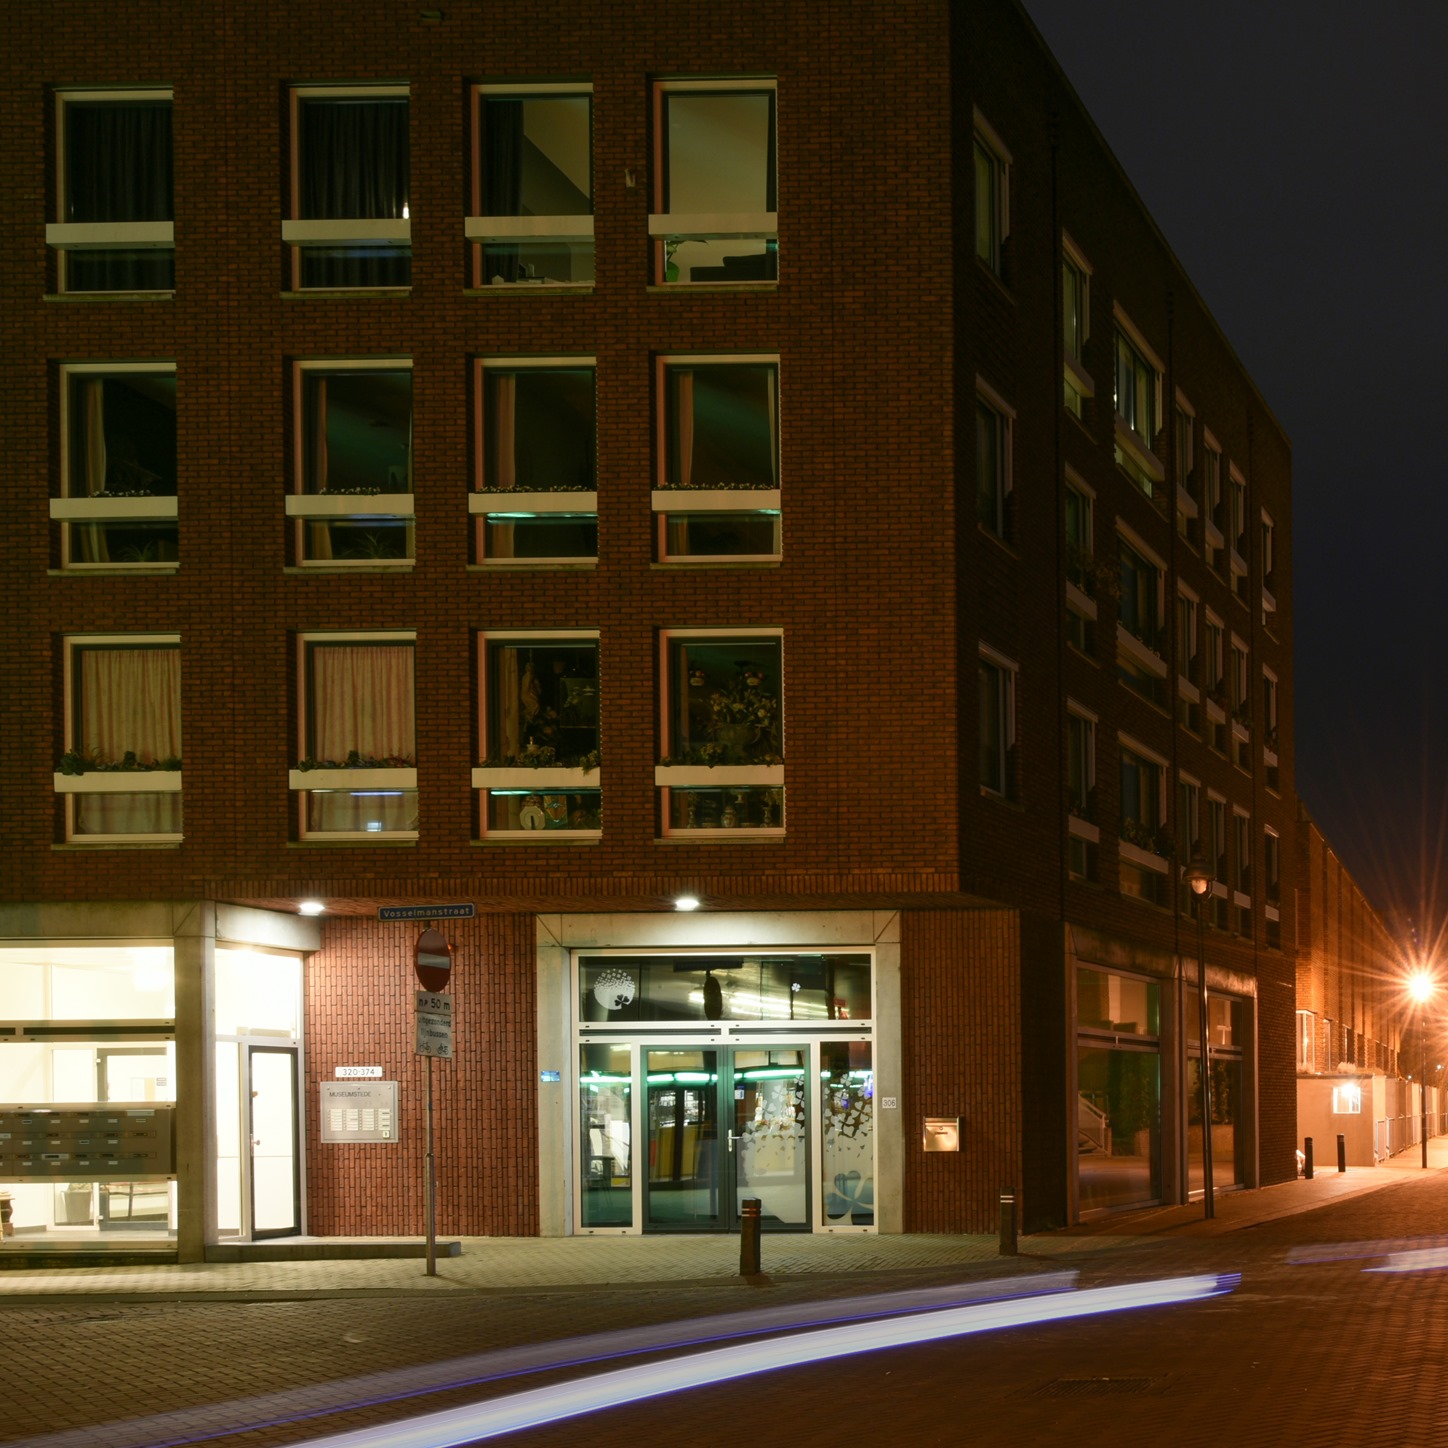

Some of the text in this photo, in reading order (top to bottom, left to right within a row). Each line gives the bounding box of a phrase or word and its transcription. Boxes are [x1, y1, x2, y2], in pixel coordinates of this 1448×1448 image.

[383, 907, 470, 918] Vosselmanstraat
[430, 998, 442, 1009] 50
[443, 1002, 451, 1011] m
[883, 1099, 896, 1107] 306
